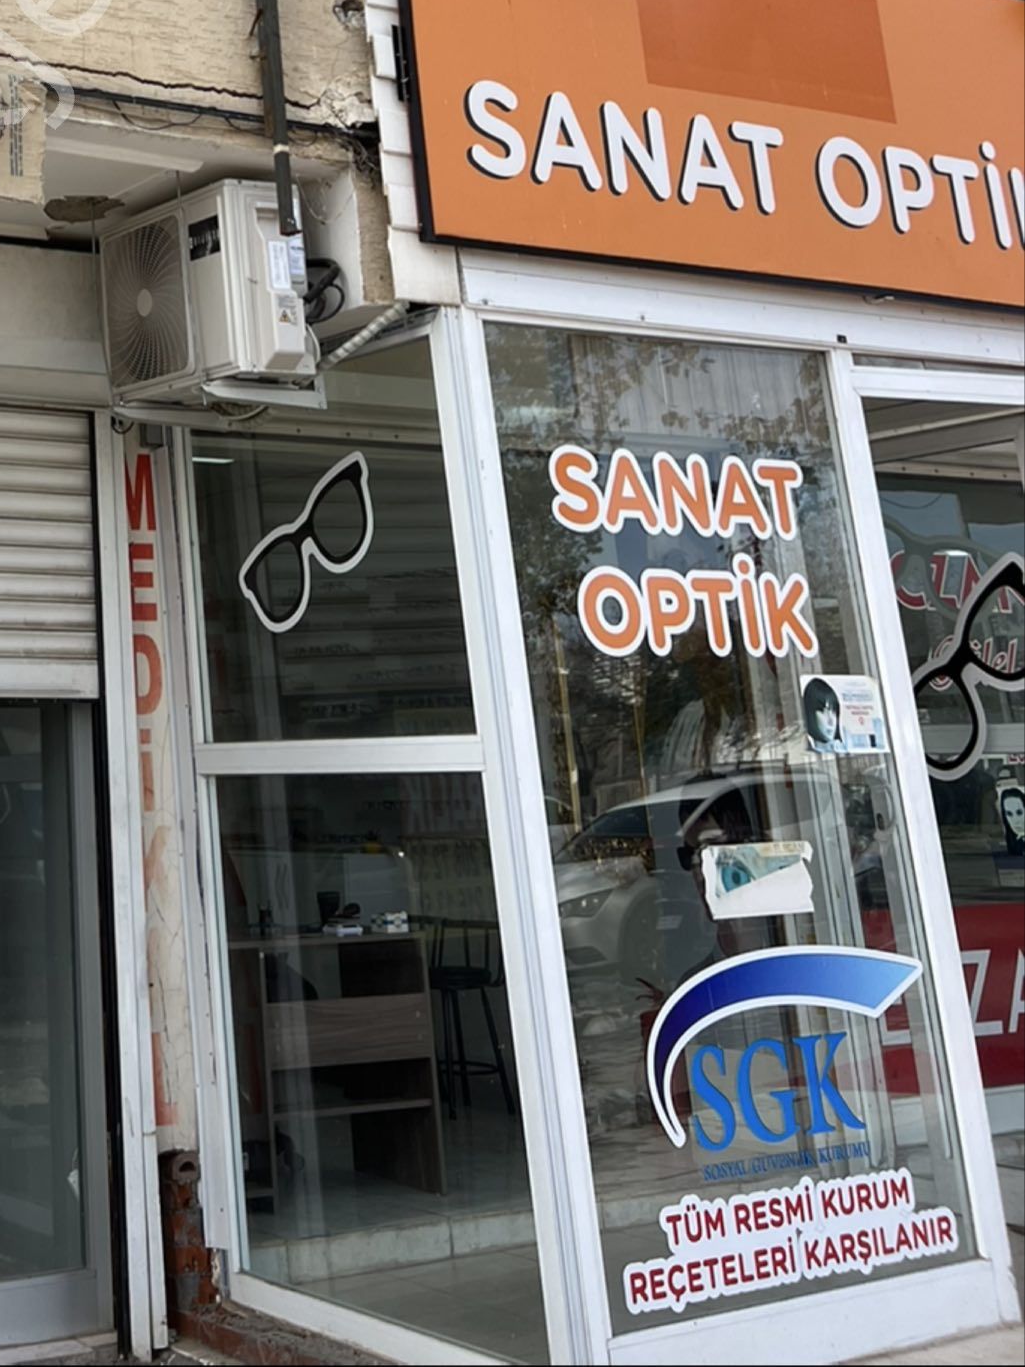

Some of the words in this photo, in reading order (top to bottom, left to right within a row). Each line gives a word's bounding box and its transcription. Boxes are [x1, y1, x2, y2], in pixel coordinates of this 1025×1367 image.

[464, 78, 784, 216] SANAT
[549, 444, 804, 541] SANAT
[578, 552, 819, 658] OPTİK
[689, 1031, 867, 1153] SGK
[629, 1238, 798, 1305] REÇETELERİ
[804, 1216, 955, 1271] KARŞILANIR
[666, 1199, 726, 1246] TÜM
[734, 1183, 815, 1232] RESMİ
[822, 1176, 912, 1216] KURUM
